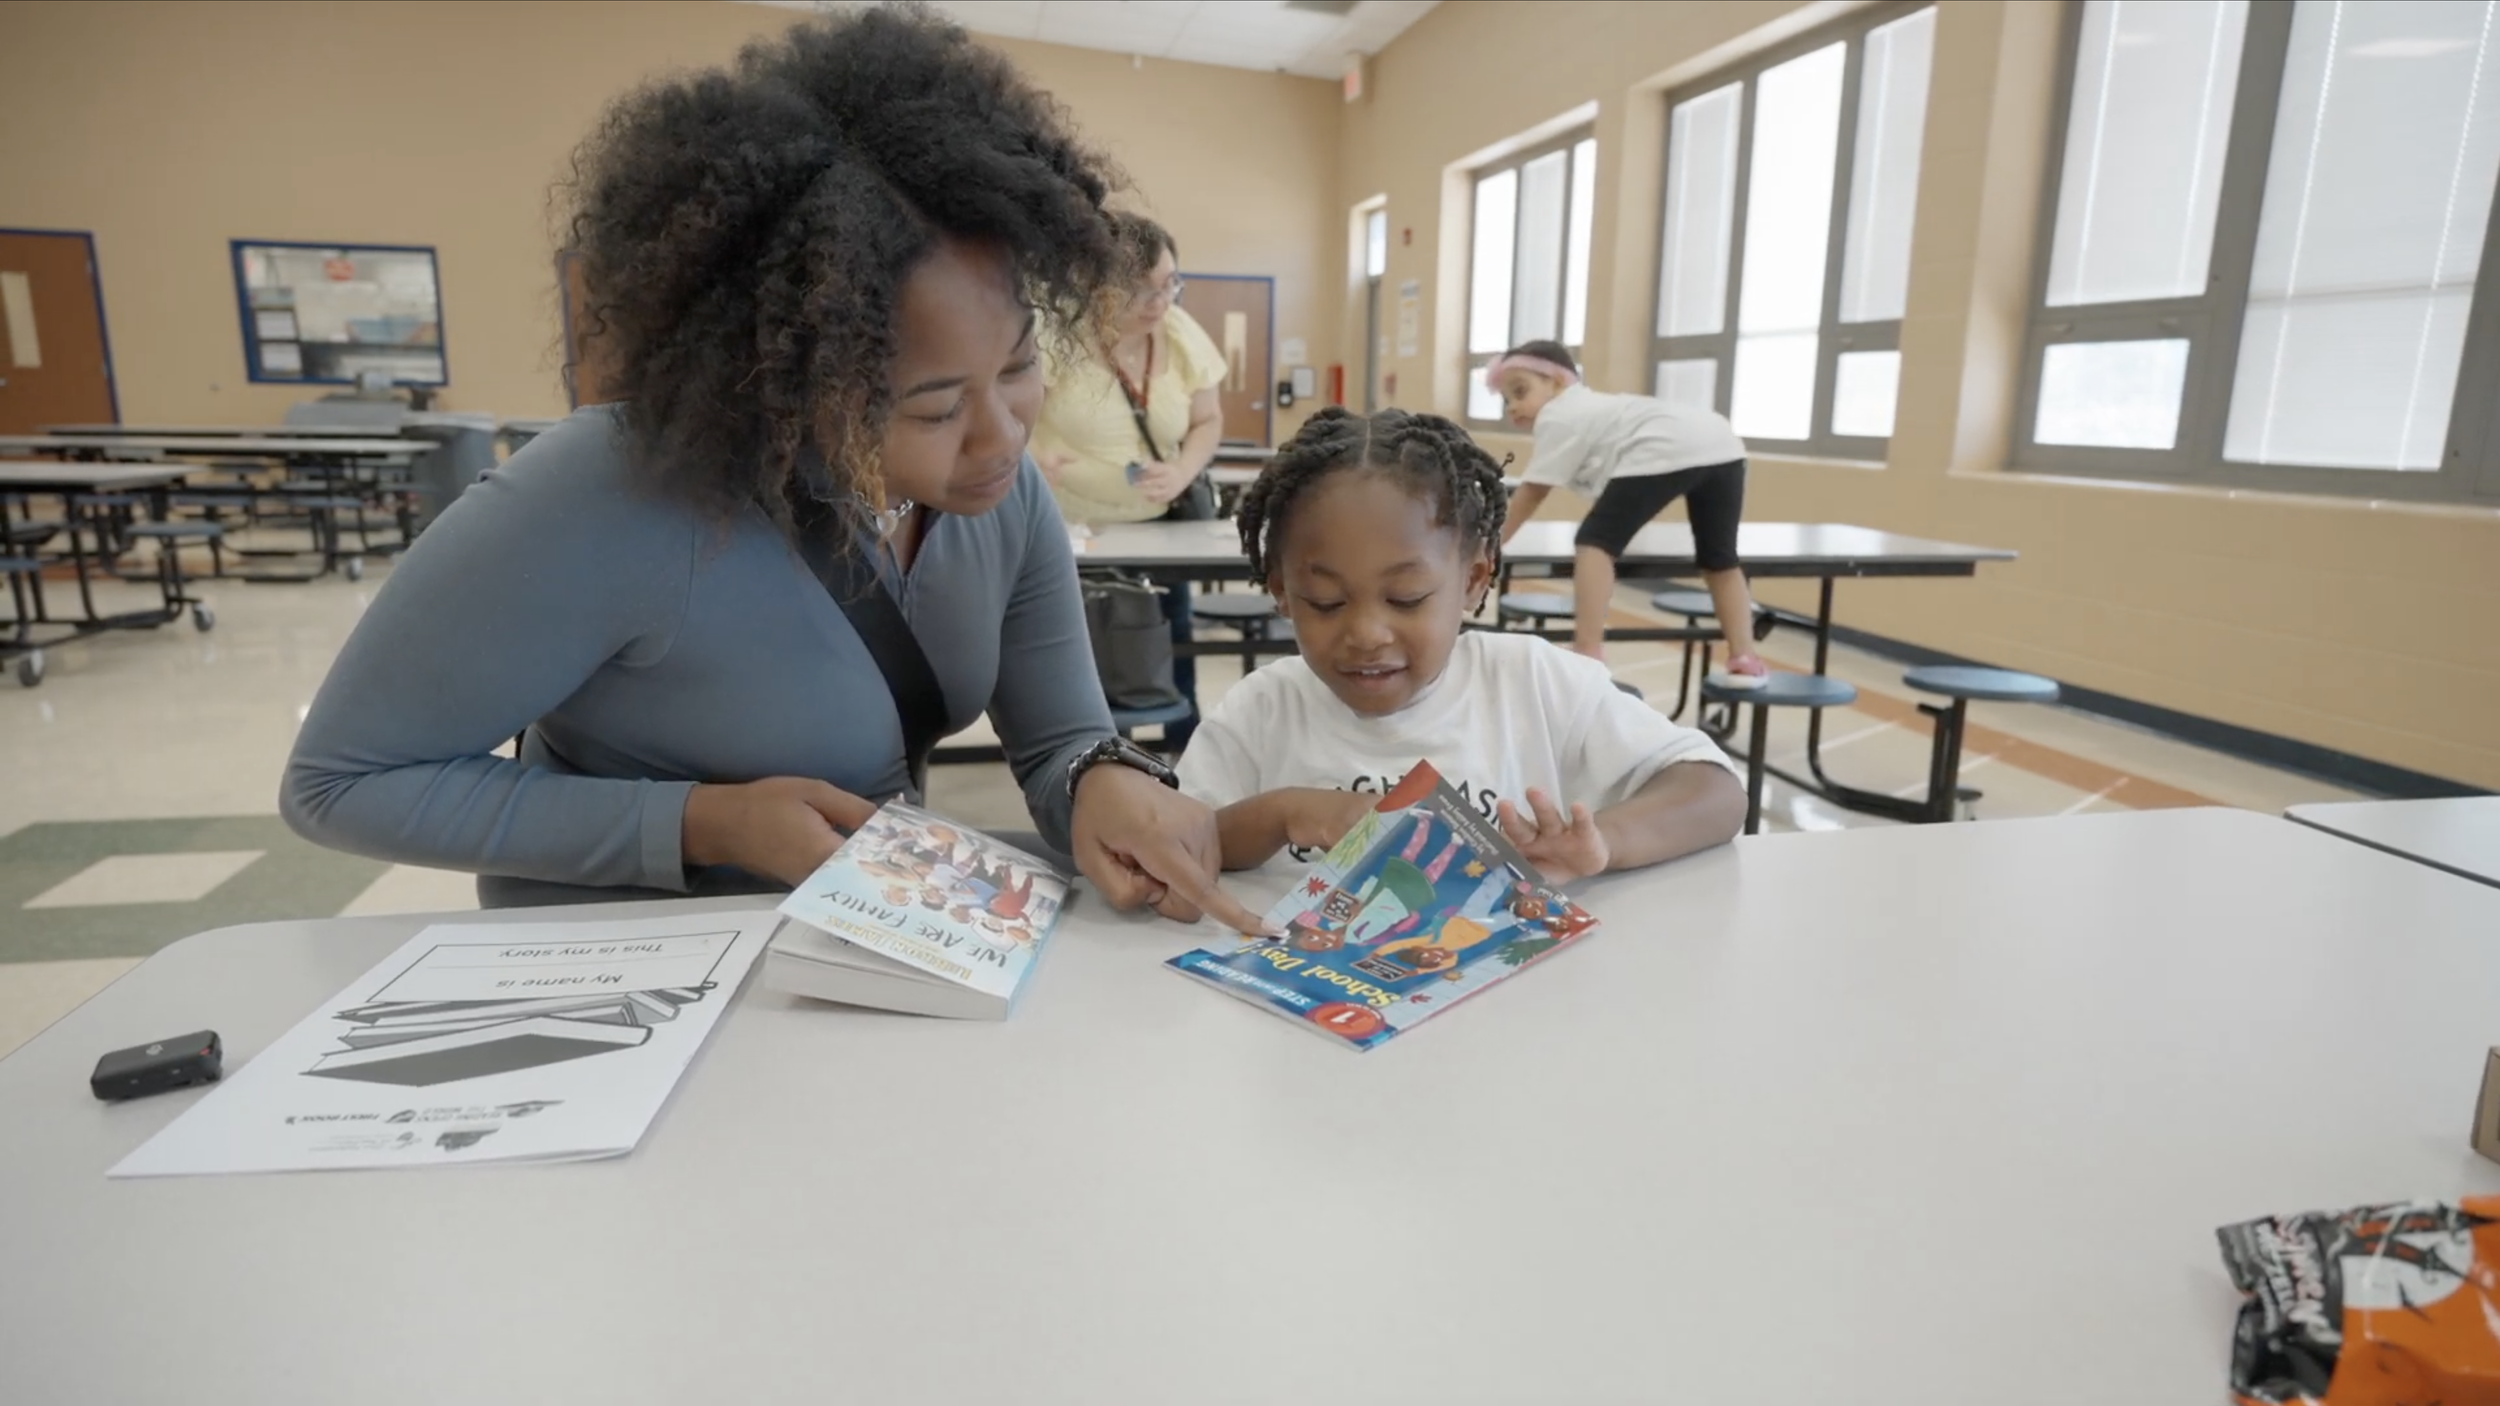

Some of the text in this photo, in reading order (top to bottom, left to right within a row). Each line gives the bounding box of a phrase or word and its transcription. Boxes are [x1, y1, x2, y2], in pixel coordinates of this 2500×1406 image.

[820, 889, 908, 929] FAMILY
[914, 920, 965, 948] ARE
[557, 947, 593, 956] my
[624, 943, 664, 953] This
[966, 944, 1008, 968] WE
[1236, 944, 1306, 972] Day!
[496, 974, 623, 988] My name is
[1197, 959, 1259, 986] READING
[1273, 986, 1311, 1006] STEP
[1300, 964, 1401, 1007] School
[1330, 1011, 1356, 1024] 1
